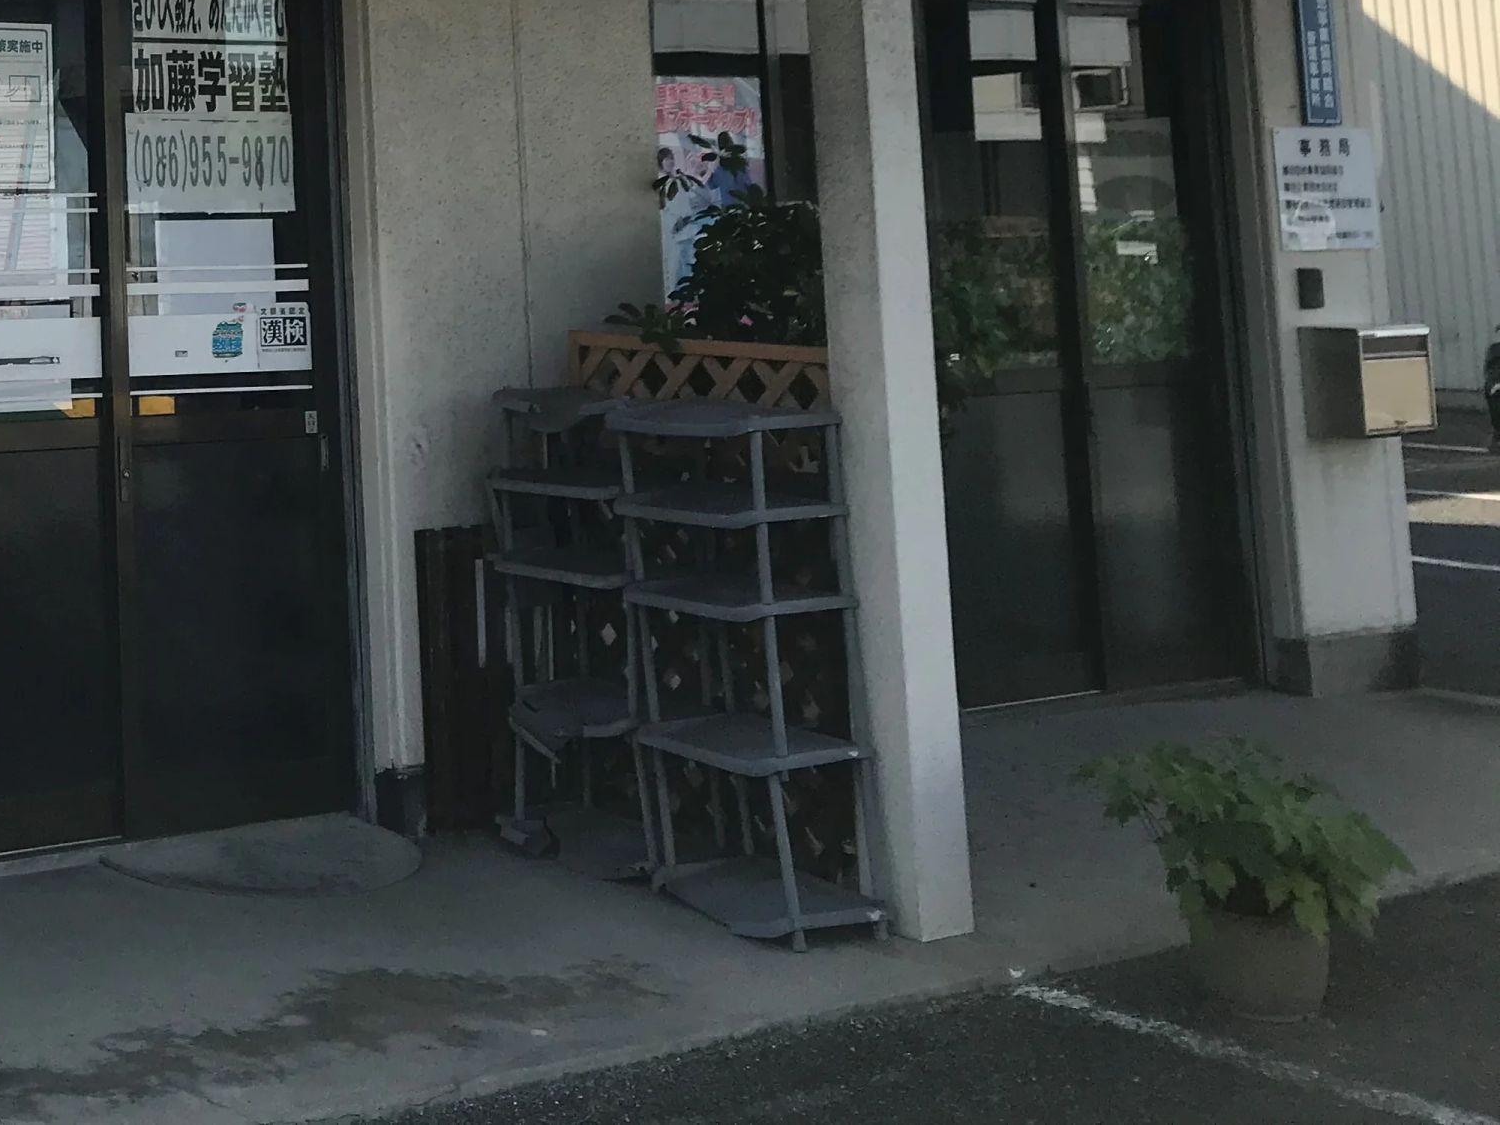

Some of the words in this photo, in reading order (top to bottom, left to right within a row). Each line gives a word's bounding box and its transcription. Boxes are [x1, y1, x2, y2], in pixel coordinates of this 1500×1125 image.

[133, 48, 289, 113] 加藤学習塾
[133, 129, 290, 192] (086)955-9870
[261, 318, 306, 344] 漢検
